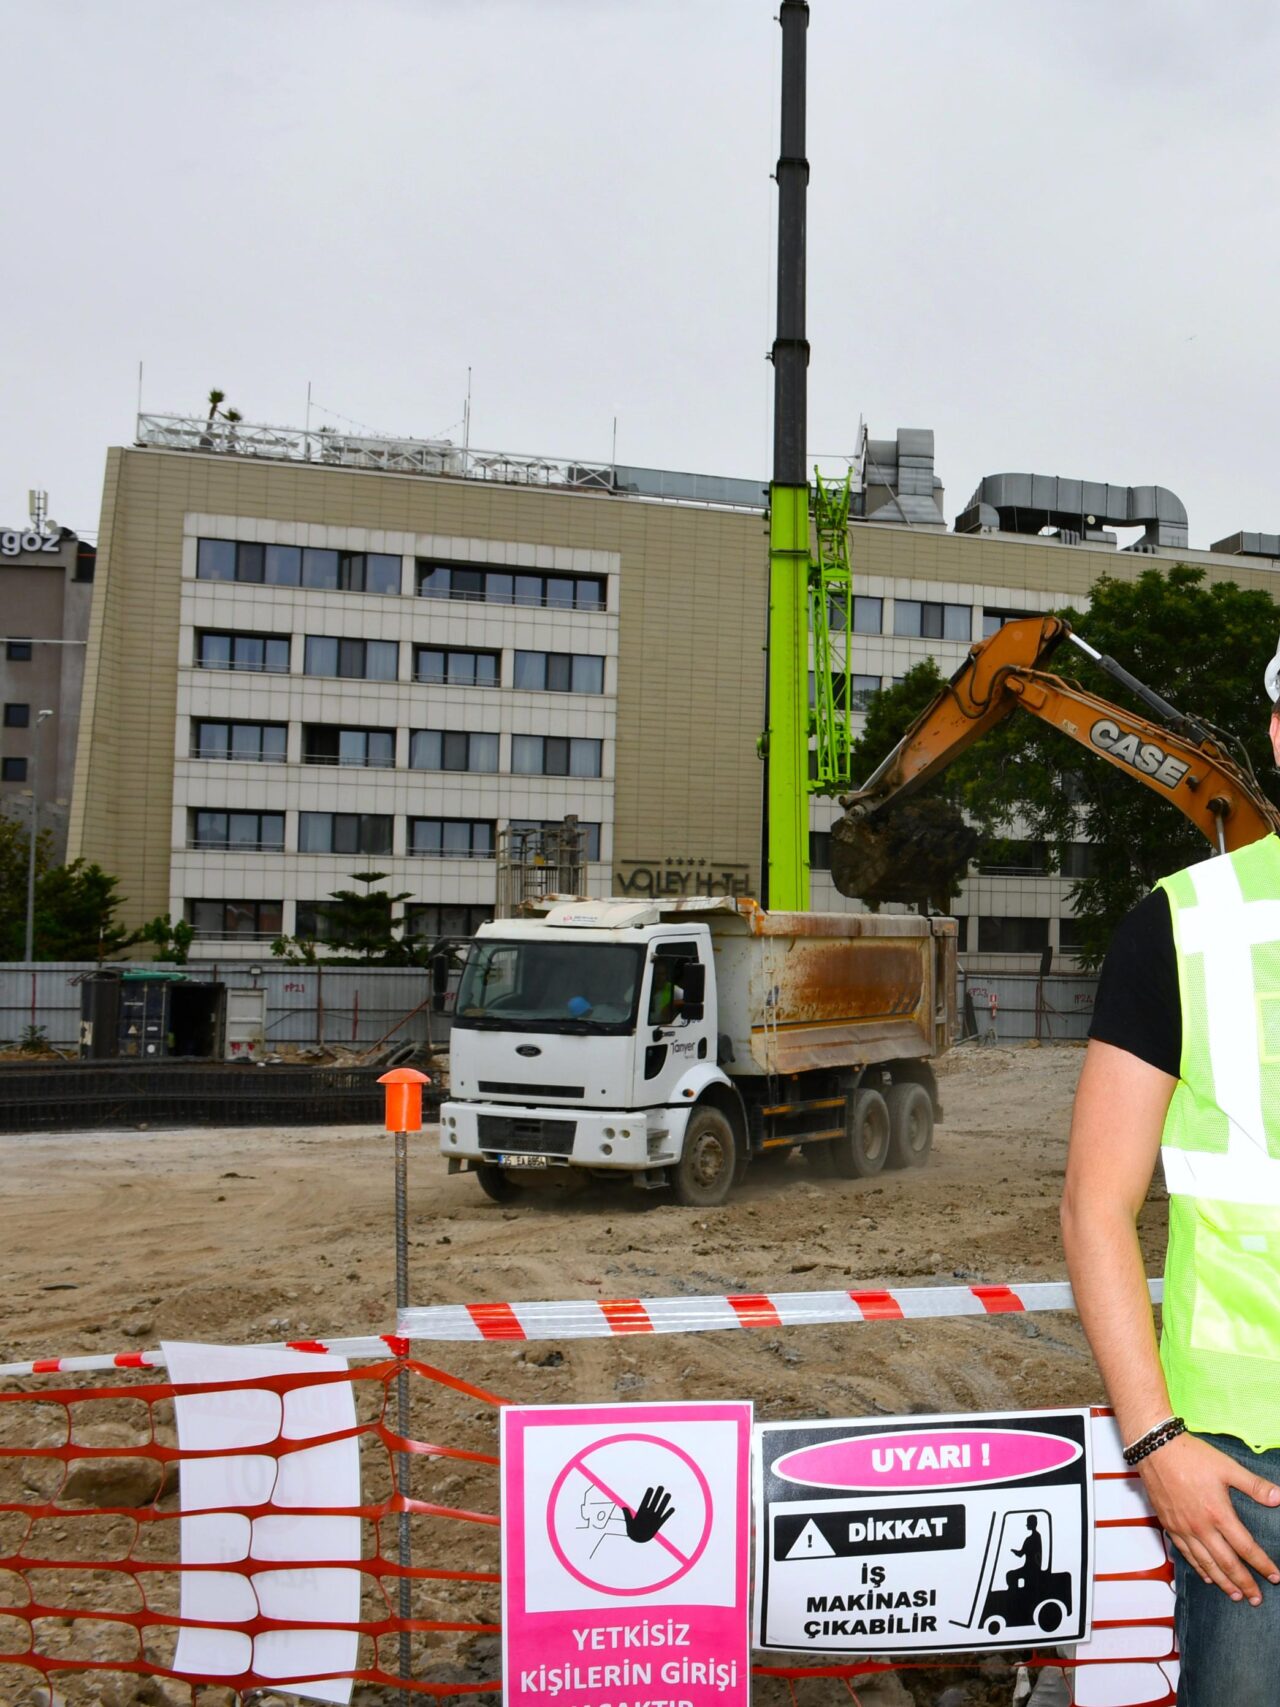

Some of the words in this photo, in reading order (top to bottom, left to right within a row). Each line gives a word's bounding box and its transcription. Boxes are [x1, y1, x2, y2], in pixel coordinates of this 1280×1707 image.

[1090, 719, 1191, 789] CASE
[670, 1039, 695, 1055] Tanyer
[871, 1444, 970, 1473] UYARI
[982, 1443, 990, 1467] !
[849, 1517, 947, 1542] DİKKAT
[861, 1563, 886, 1588] İŞ
[806, 1590, 936, 1613] MAKİNASI
[572, 1619, 690, 1651] YETKİSİZ
[804, 1613, 937, 1639] ÇIKABİLİR
[521, 1659, 652, 1696] KİŞİLERİN
[660, 1657, 737, 1691] GİRİŞİ
